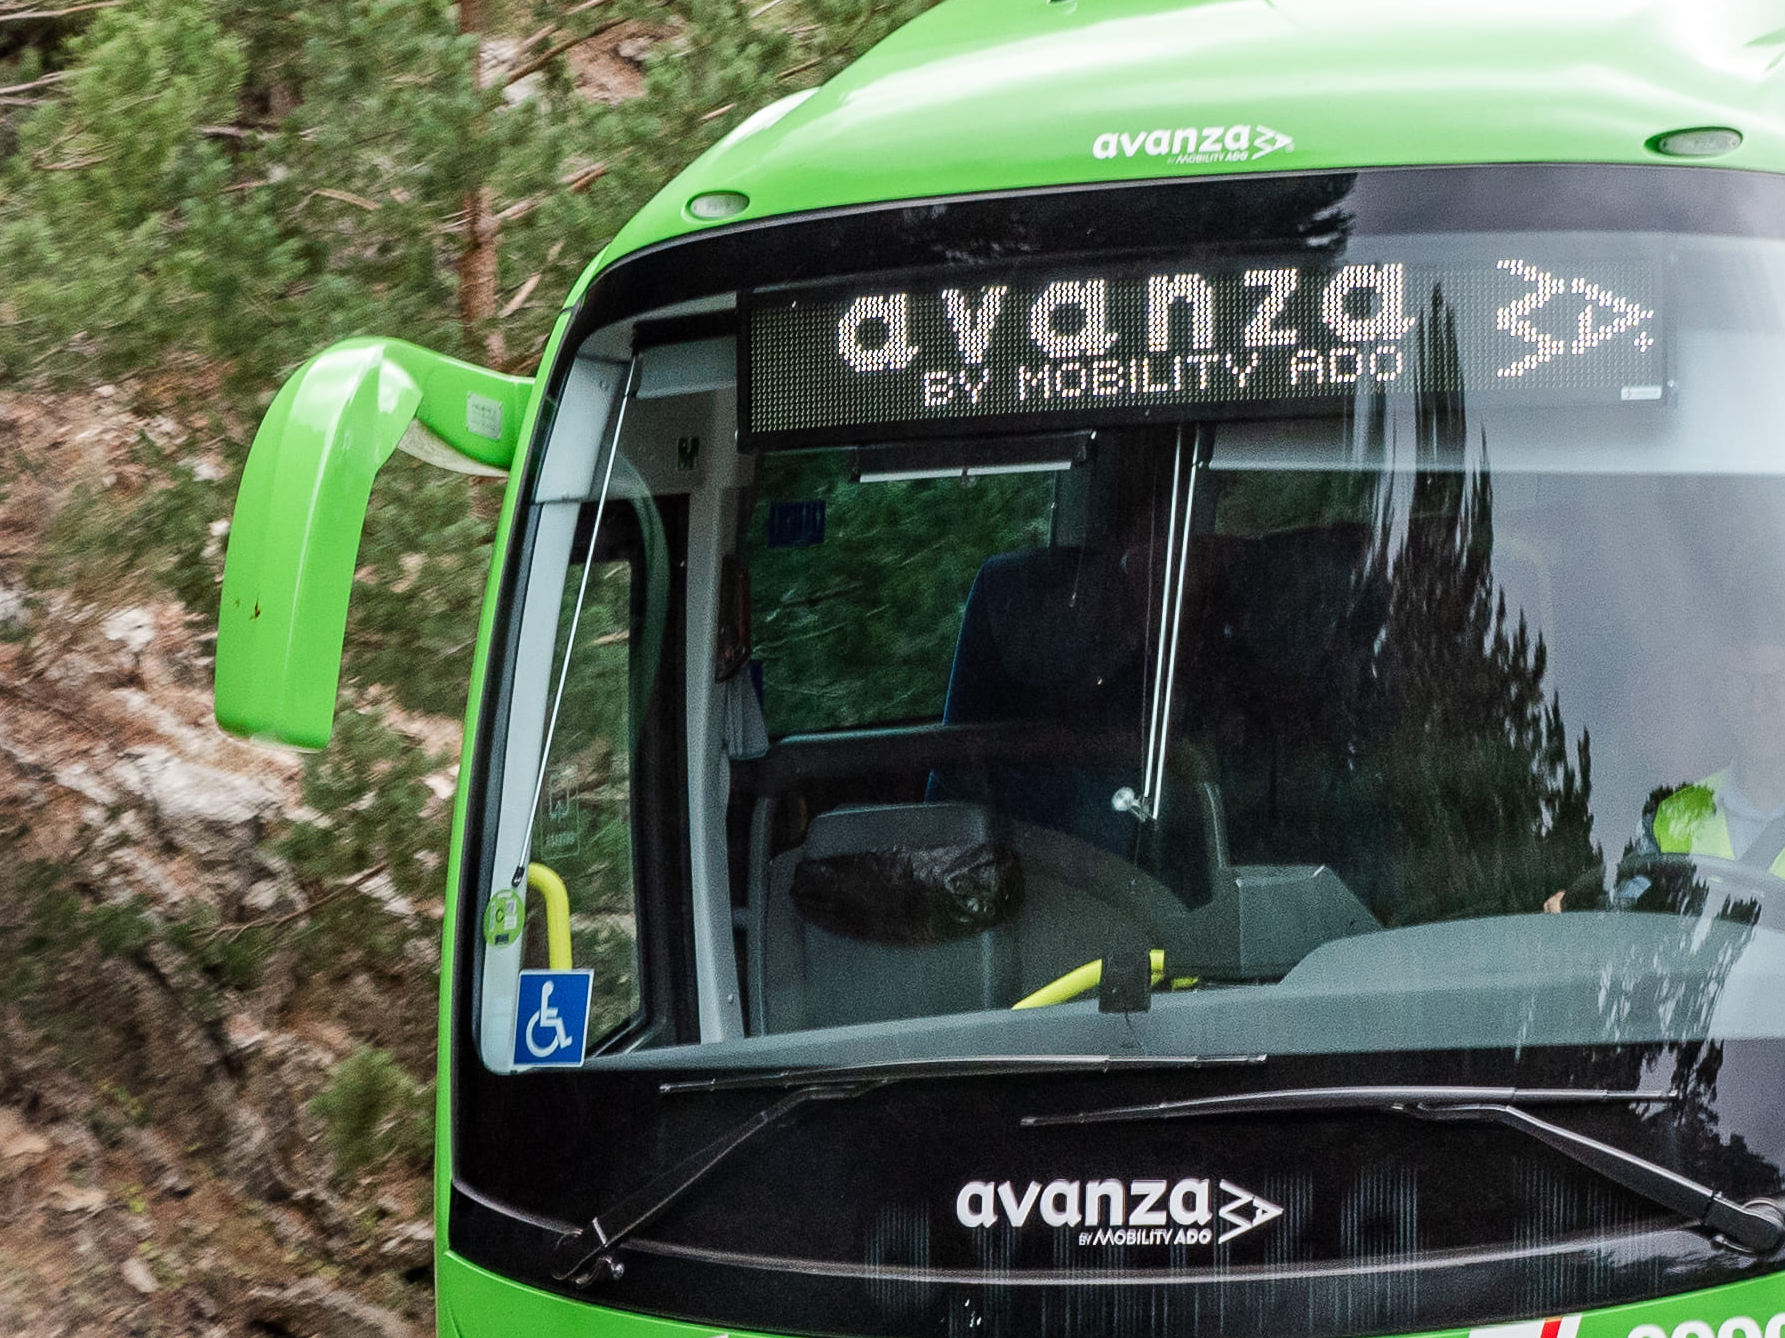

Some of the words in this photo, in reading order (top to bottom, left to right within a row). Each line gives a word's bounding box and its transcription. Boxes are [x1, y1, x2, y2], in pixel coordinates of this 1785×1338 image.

[1092, 124, 1251, 159] avanza
[1175, 152, 1224, 165] MOBILITY
[837, 261, 1414, 373] avanza
[924, 367, 990, 407] BY
[1019, 352, 1260, 401] MOBILITY
[1290, 344, 1404, 386] ADO
[956, 1178, 1213, 1228] avanza
[1078, 1232, 1093, 1246] BY
[1092, 1229, 1173, 1246] MOBILITY
[1173, 1229, 1213, 1245] ADO
